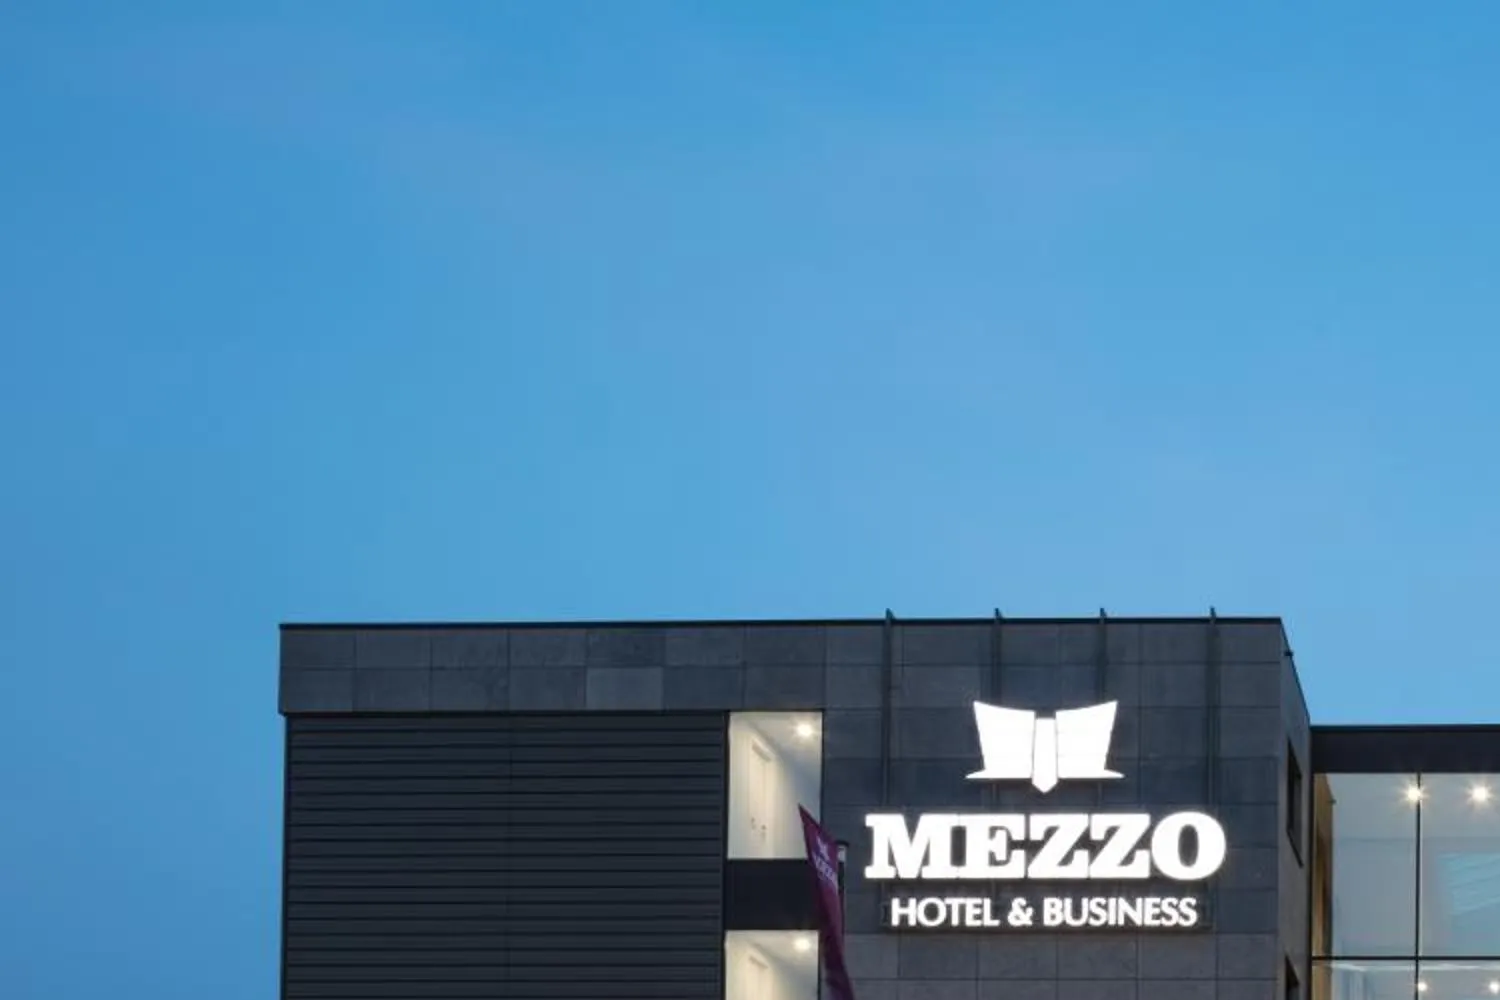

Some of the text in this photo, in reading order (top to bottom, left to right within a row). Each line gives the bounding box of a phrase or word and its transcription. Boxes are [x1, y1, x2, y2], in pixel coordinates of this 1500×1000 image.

[864, 810, 1227, 881] MEZZO
[891, 896, 1198, 927] HOTEL & BUSINESS
